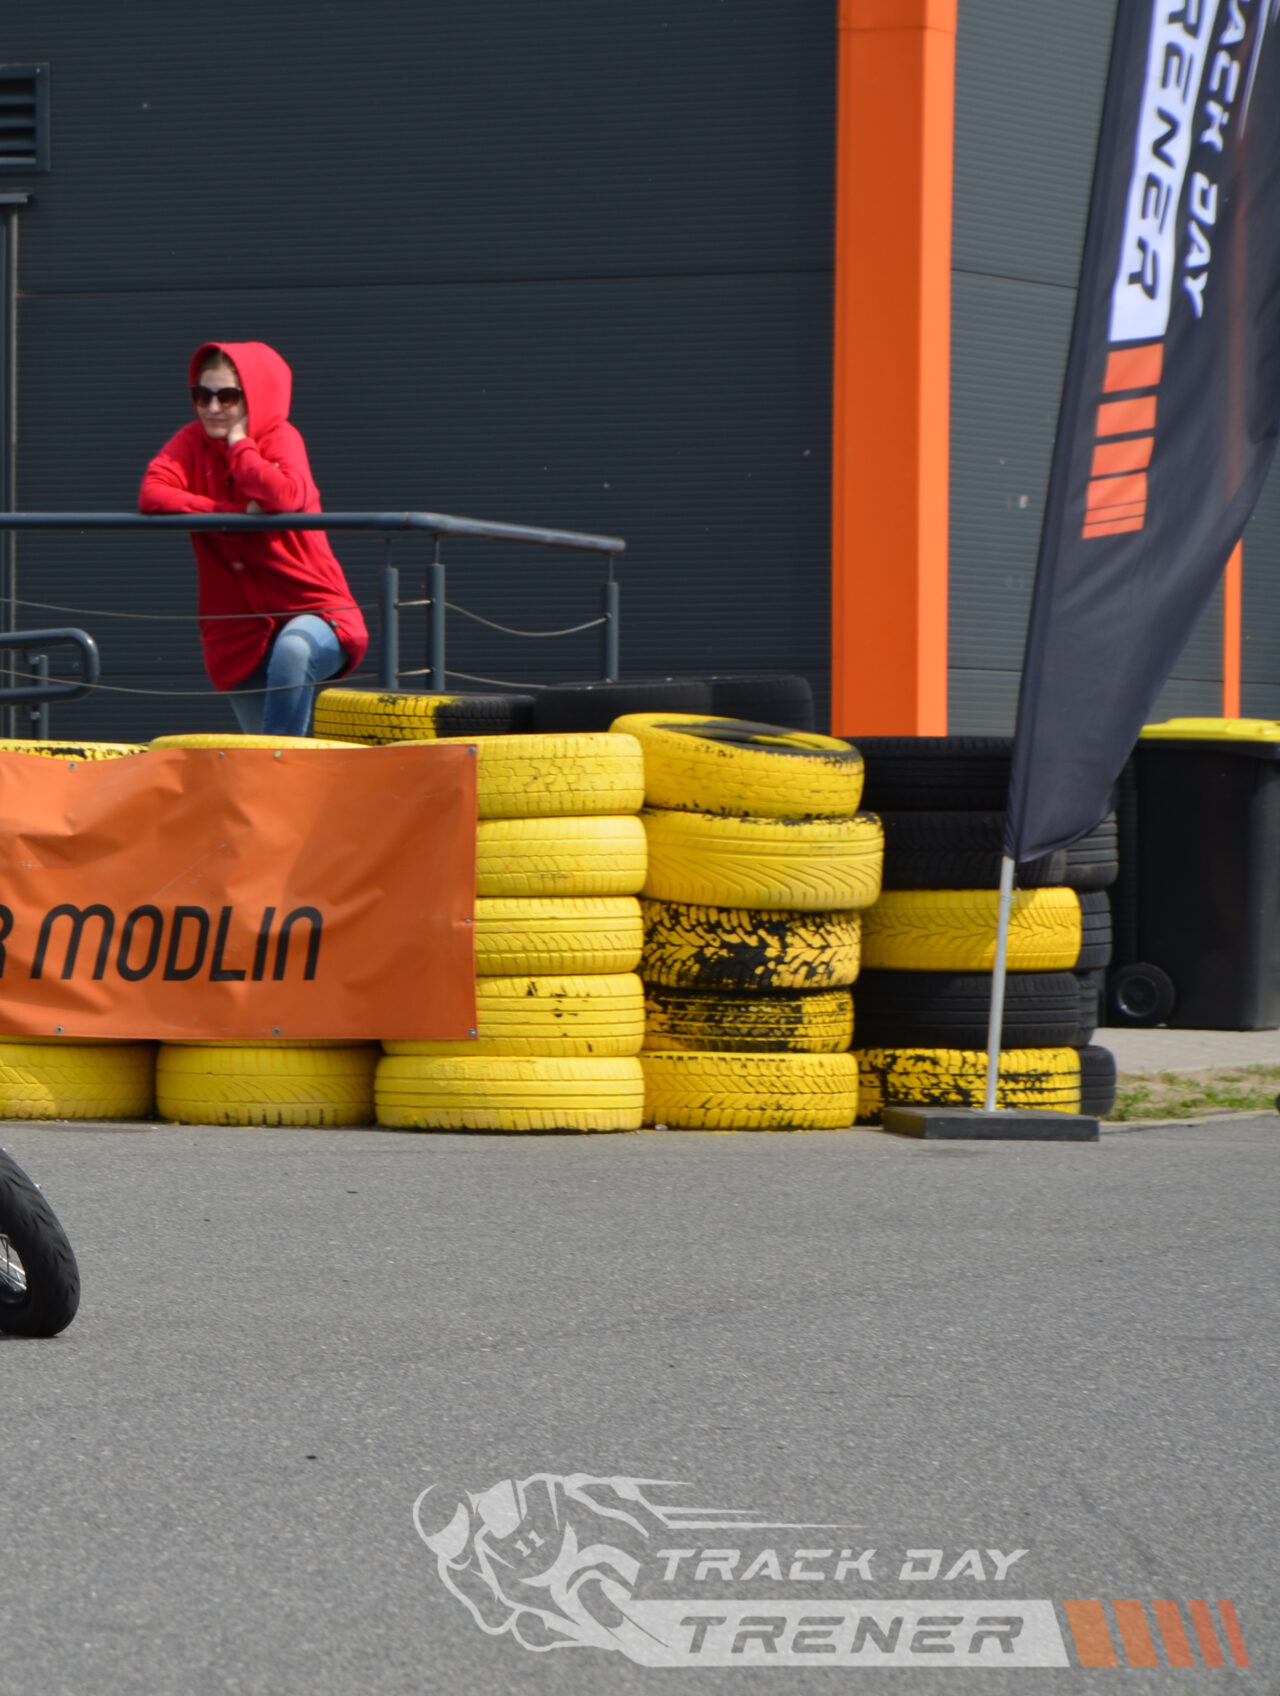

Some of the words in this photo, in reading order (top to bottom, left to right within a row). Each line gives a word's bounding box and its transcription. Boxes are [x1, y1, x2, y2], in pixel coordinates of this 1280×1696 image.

[1200, 0, 1249, 152] ACK
[1183, 171, 1219, 318] DAY
[30, 905, 324, 981] MODLIN
